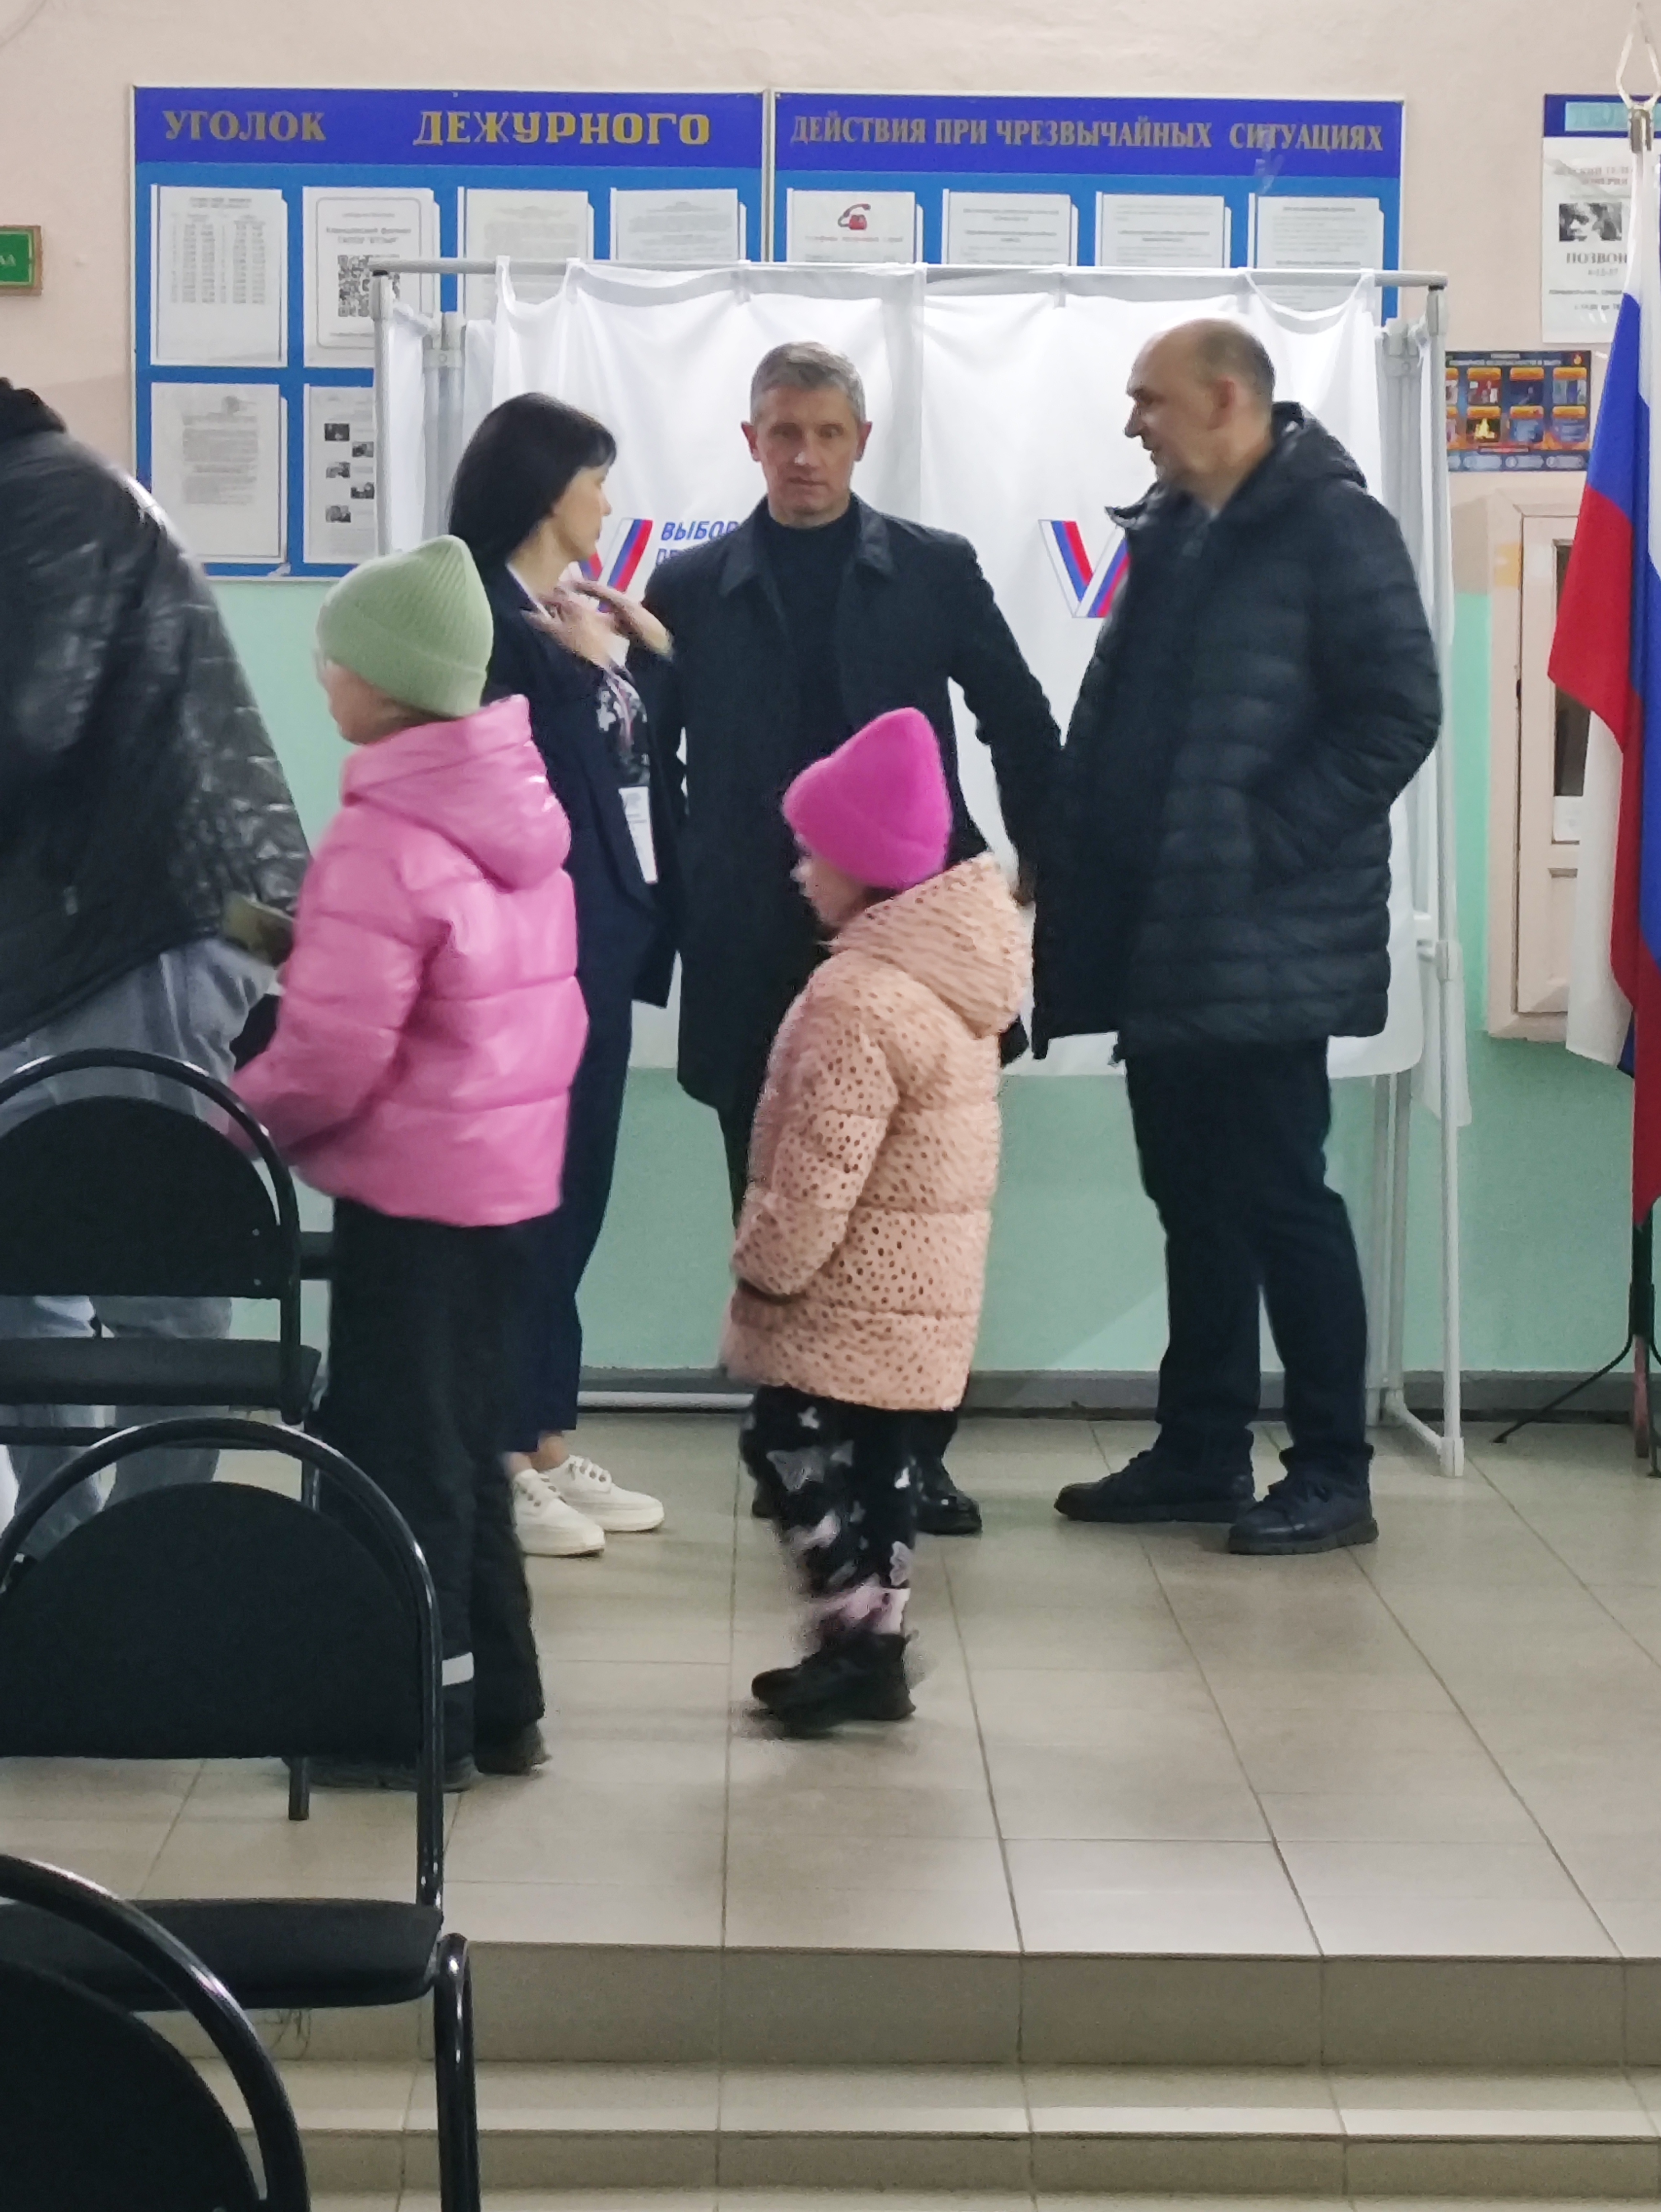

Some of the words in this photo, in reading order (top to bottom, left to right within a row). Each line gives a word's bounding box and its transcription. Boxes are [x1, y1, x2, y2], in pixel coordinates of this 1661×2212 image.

[162, 110, 326, 141] УГОЛОК
[413, 110, 710, 146] ДЕЖУРНОГО
[790, 110, 926, 144] ДЕЙСТВИЯ
[934, 118, 987, 144] ПРИ
[996, 115, 1212, 148] ЧРЕЗВЫЧАЙНЫХ
[1229, 123, 1384, 154] СИТУАЦИЯХ
